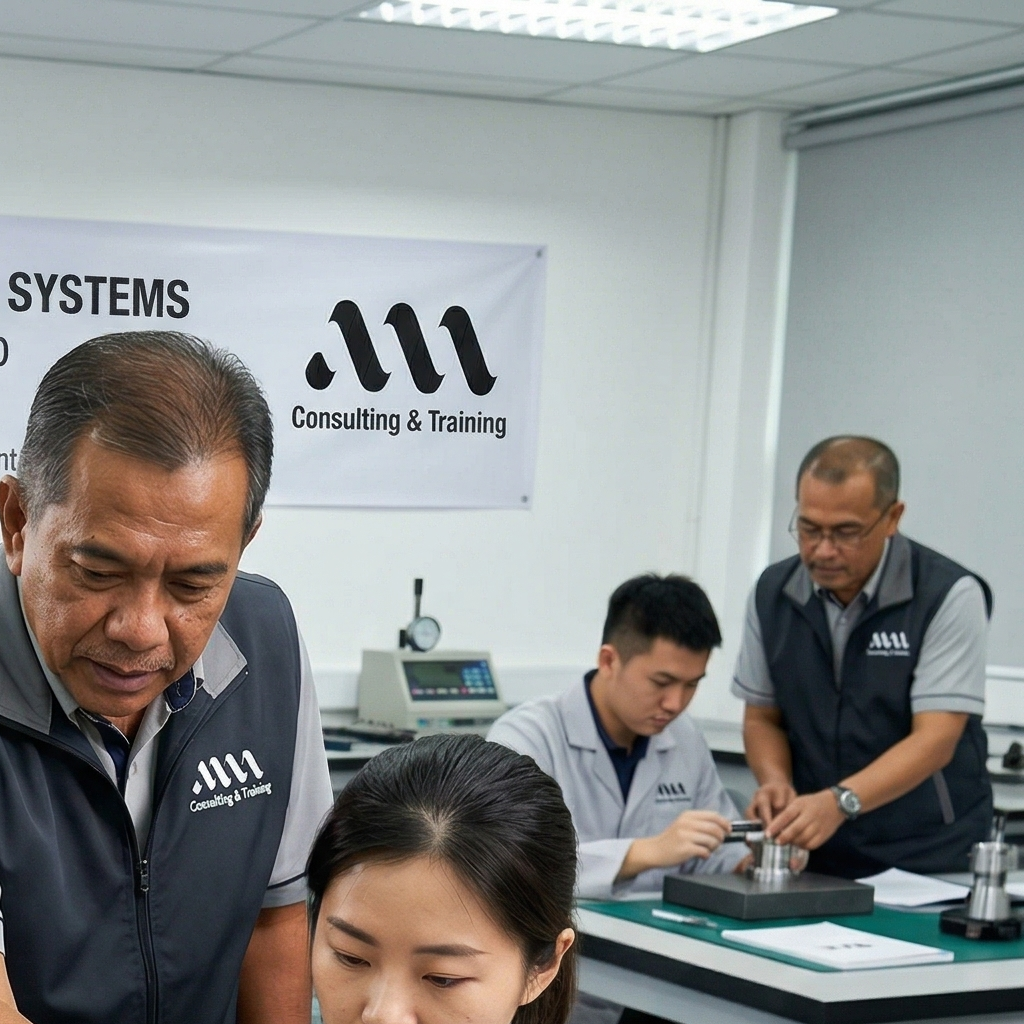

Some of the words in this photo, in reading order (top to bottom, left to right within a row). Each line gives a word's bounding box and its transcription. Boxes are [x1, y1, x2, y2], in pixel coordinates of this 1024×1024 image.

[7, 271, 190, 319] SYSTEMS
[291, 405, 401, 437] Consulting
[406, 409, 422, 432] &
[427, 409, 507, 440] Training
